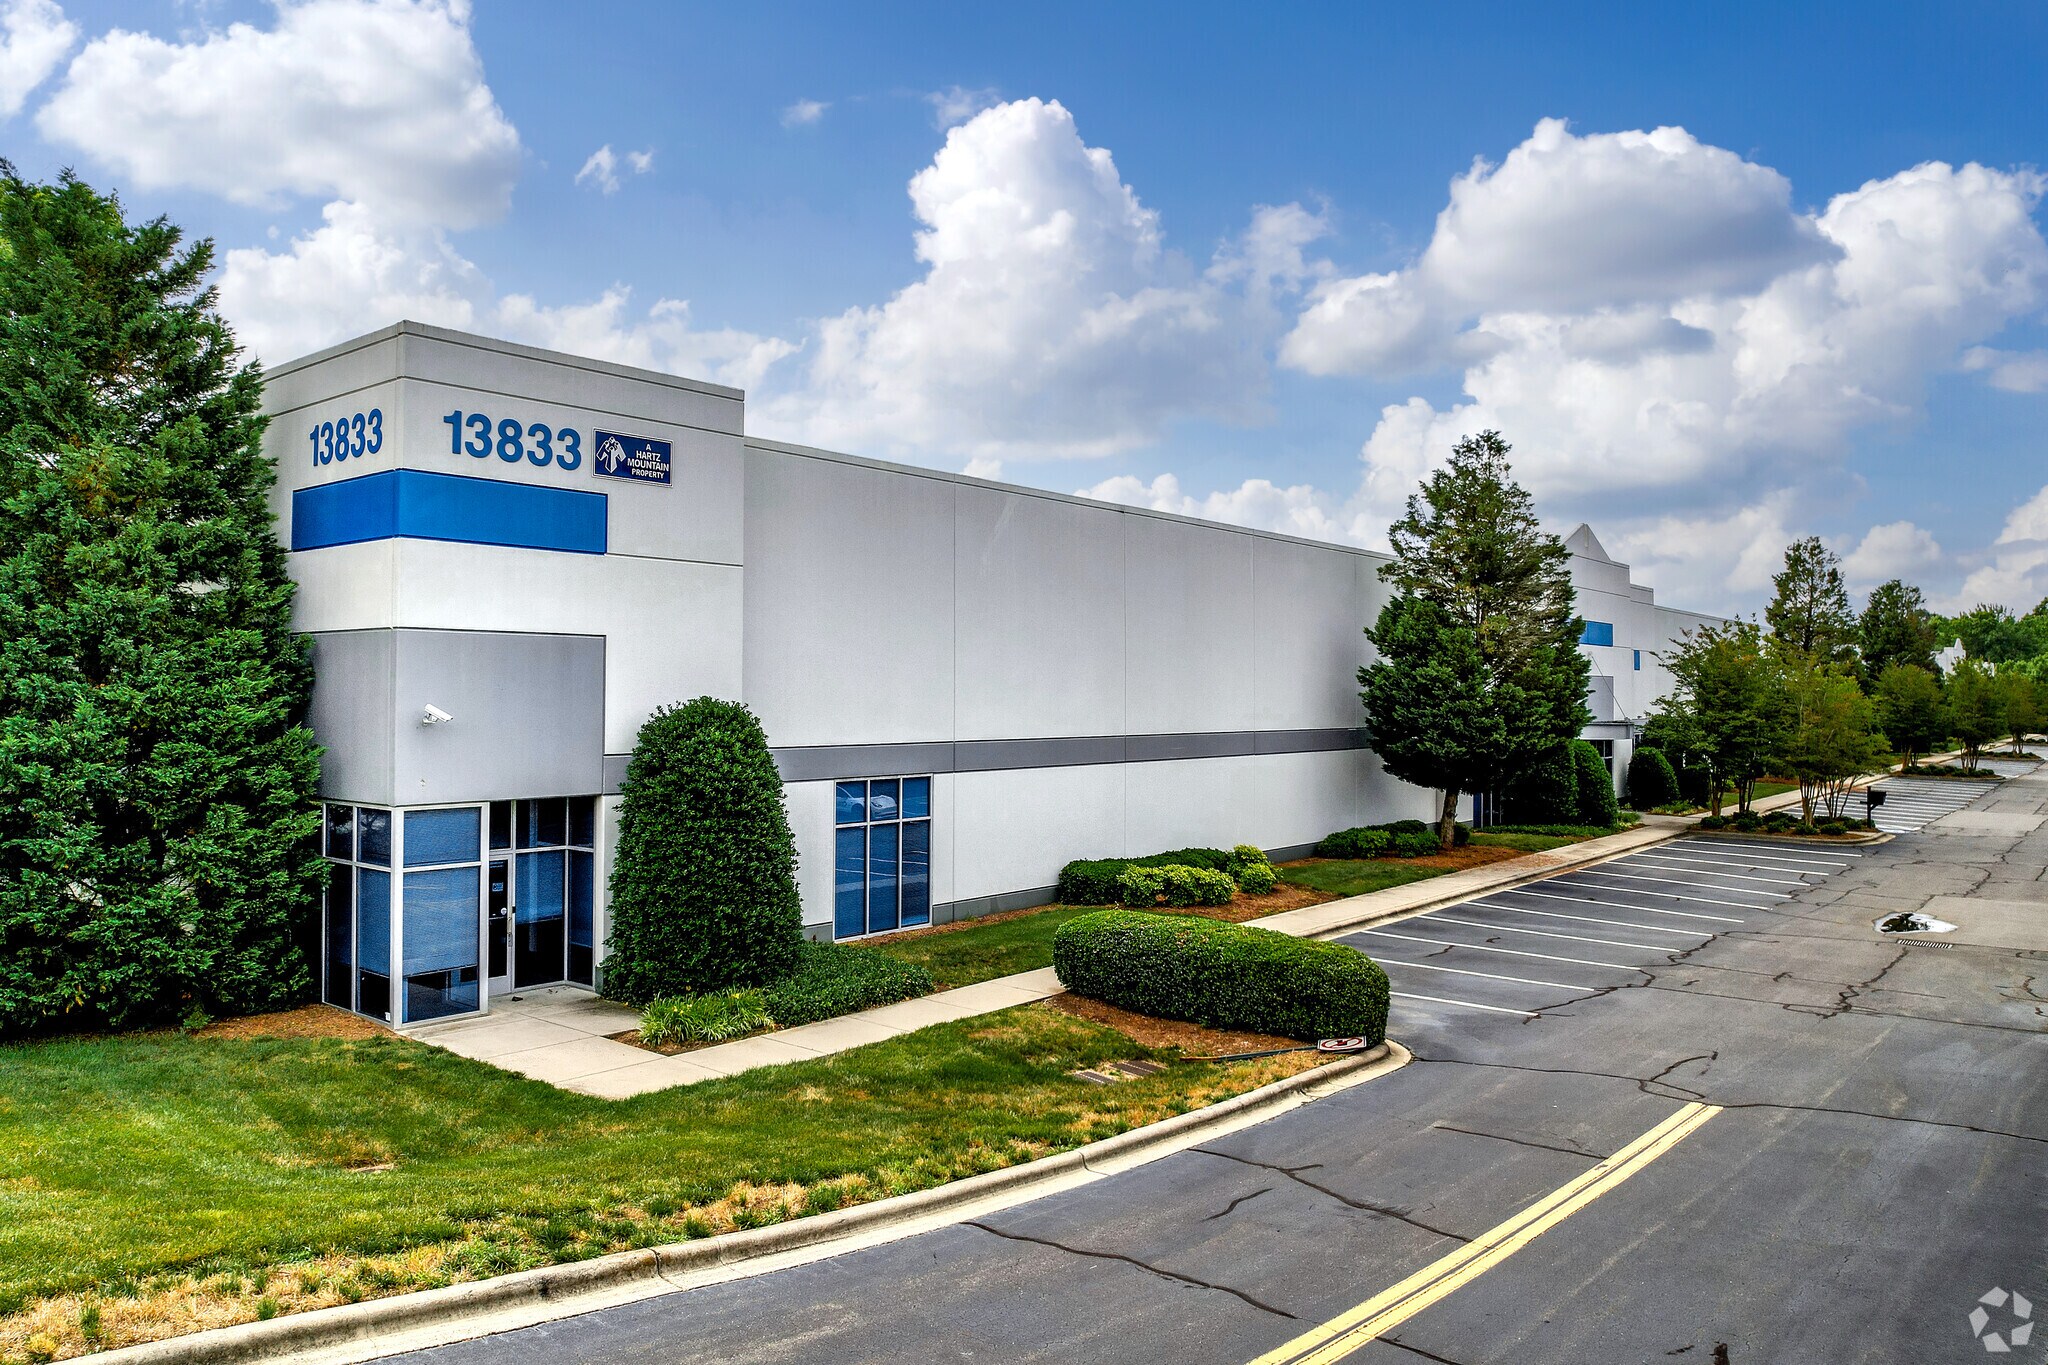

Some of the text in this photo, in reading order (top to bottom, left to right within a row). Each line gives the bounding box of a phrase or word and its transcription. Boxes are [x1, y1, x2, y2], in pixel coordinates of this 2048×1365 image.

[310, 408, 382, 466] 13833
[444, 410, 581, 471] 13833
[646, 443, 651, 451] A
[636, 450, 661, 461] HARTZ
[627, 458, 669, 471] MOUNTAIN
[632, 469, 664, 478] PROPERTY
